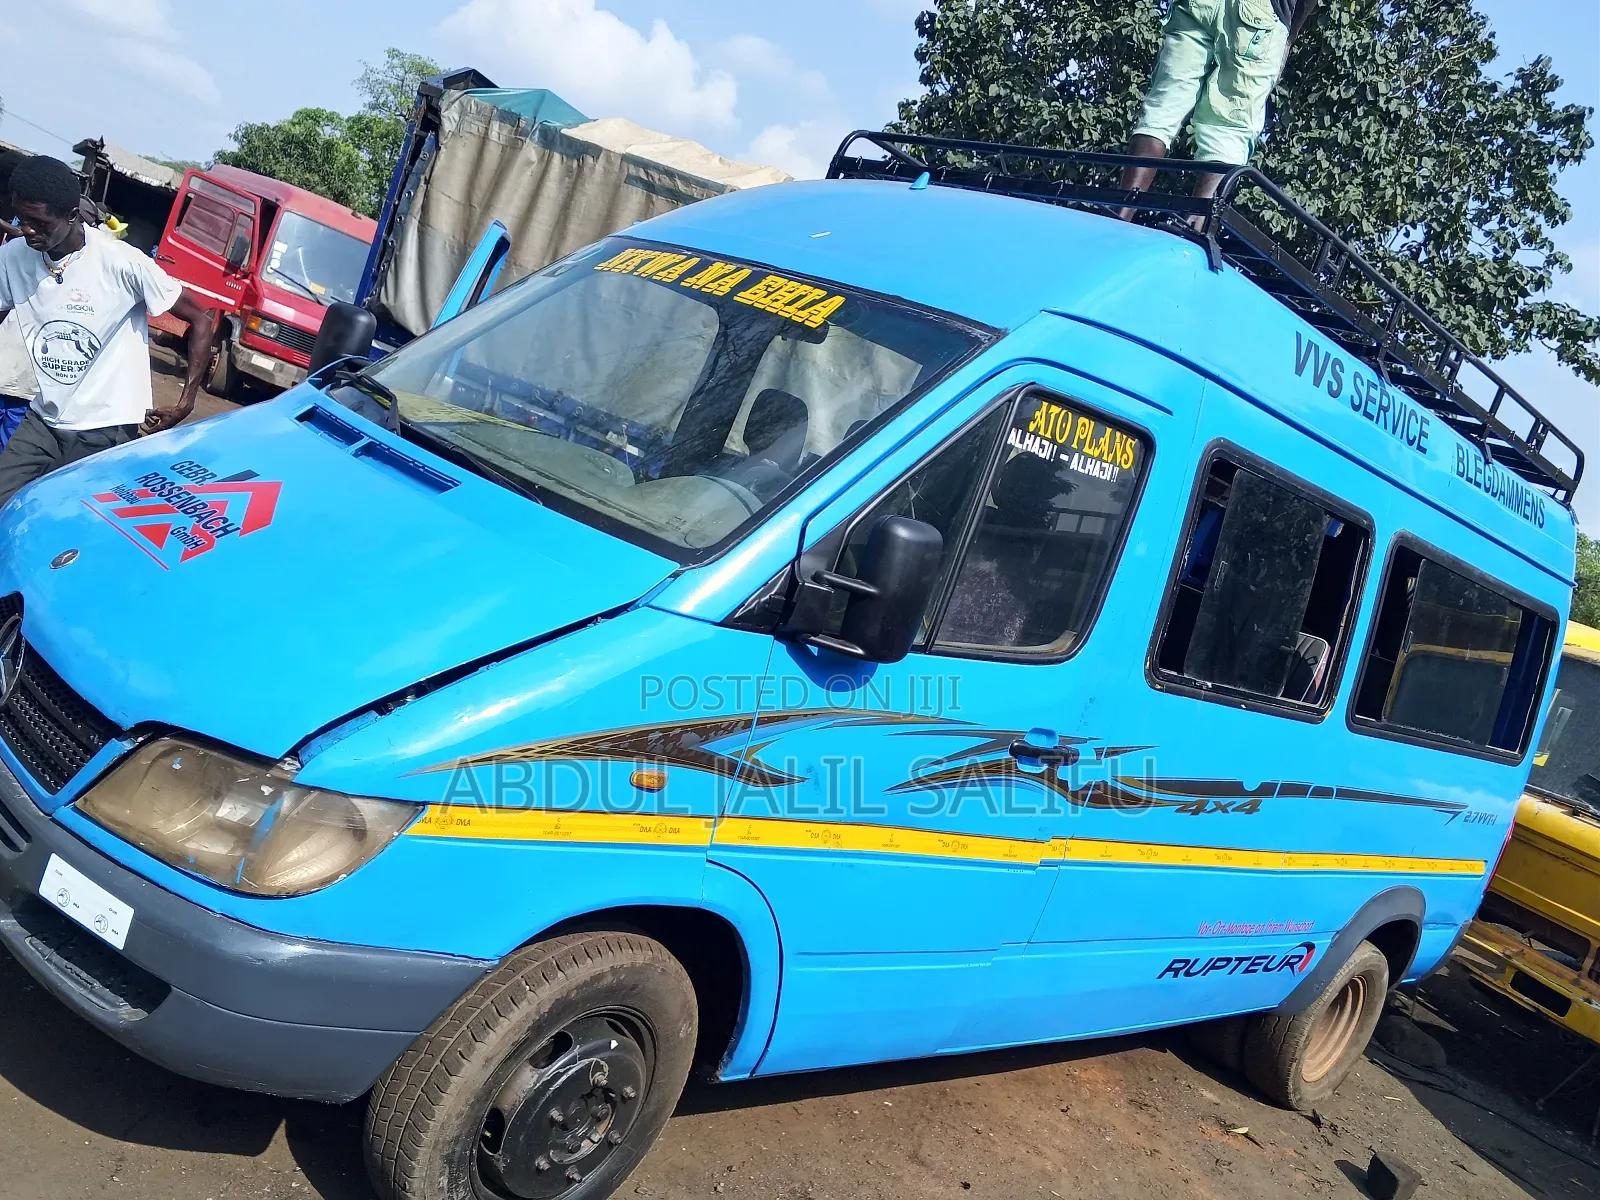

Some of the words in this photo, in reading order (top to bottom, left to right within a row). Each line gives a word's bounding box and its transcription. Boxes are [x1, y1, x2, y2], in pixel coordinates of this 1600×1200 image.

[680, 261, 753, 296] NA
[732, 274, 846, 329] EHIA
[41, 355, 60, 364] HIGH
[41, 361, 74, 373] SUPER
[1028, 401, 1073, 444] ATO
[1071, 416, 1137, 470] PLANS
[1294, 331, 1345, 399] VVS
[1349, 370, 1430, 455] SERVICE
[1455, 442, 1545, 530] BLEGDAMMENS
[169, 460, 218, 487] GEBR.
[134, 471, 241, 539] ROSSENBACH
[170, 525, 206, 550] GmbH
[1157, 954, 1305, 980] RUPTEUR
